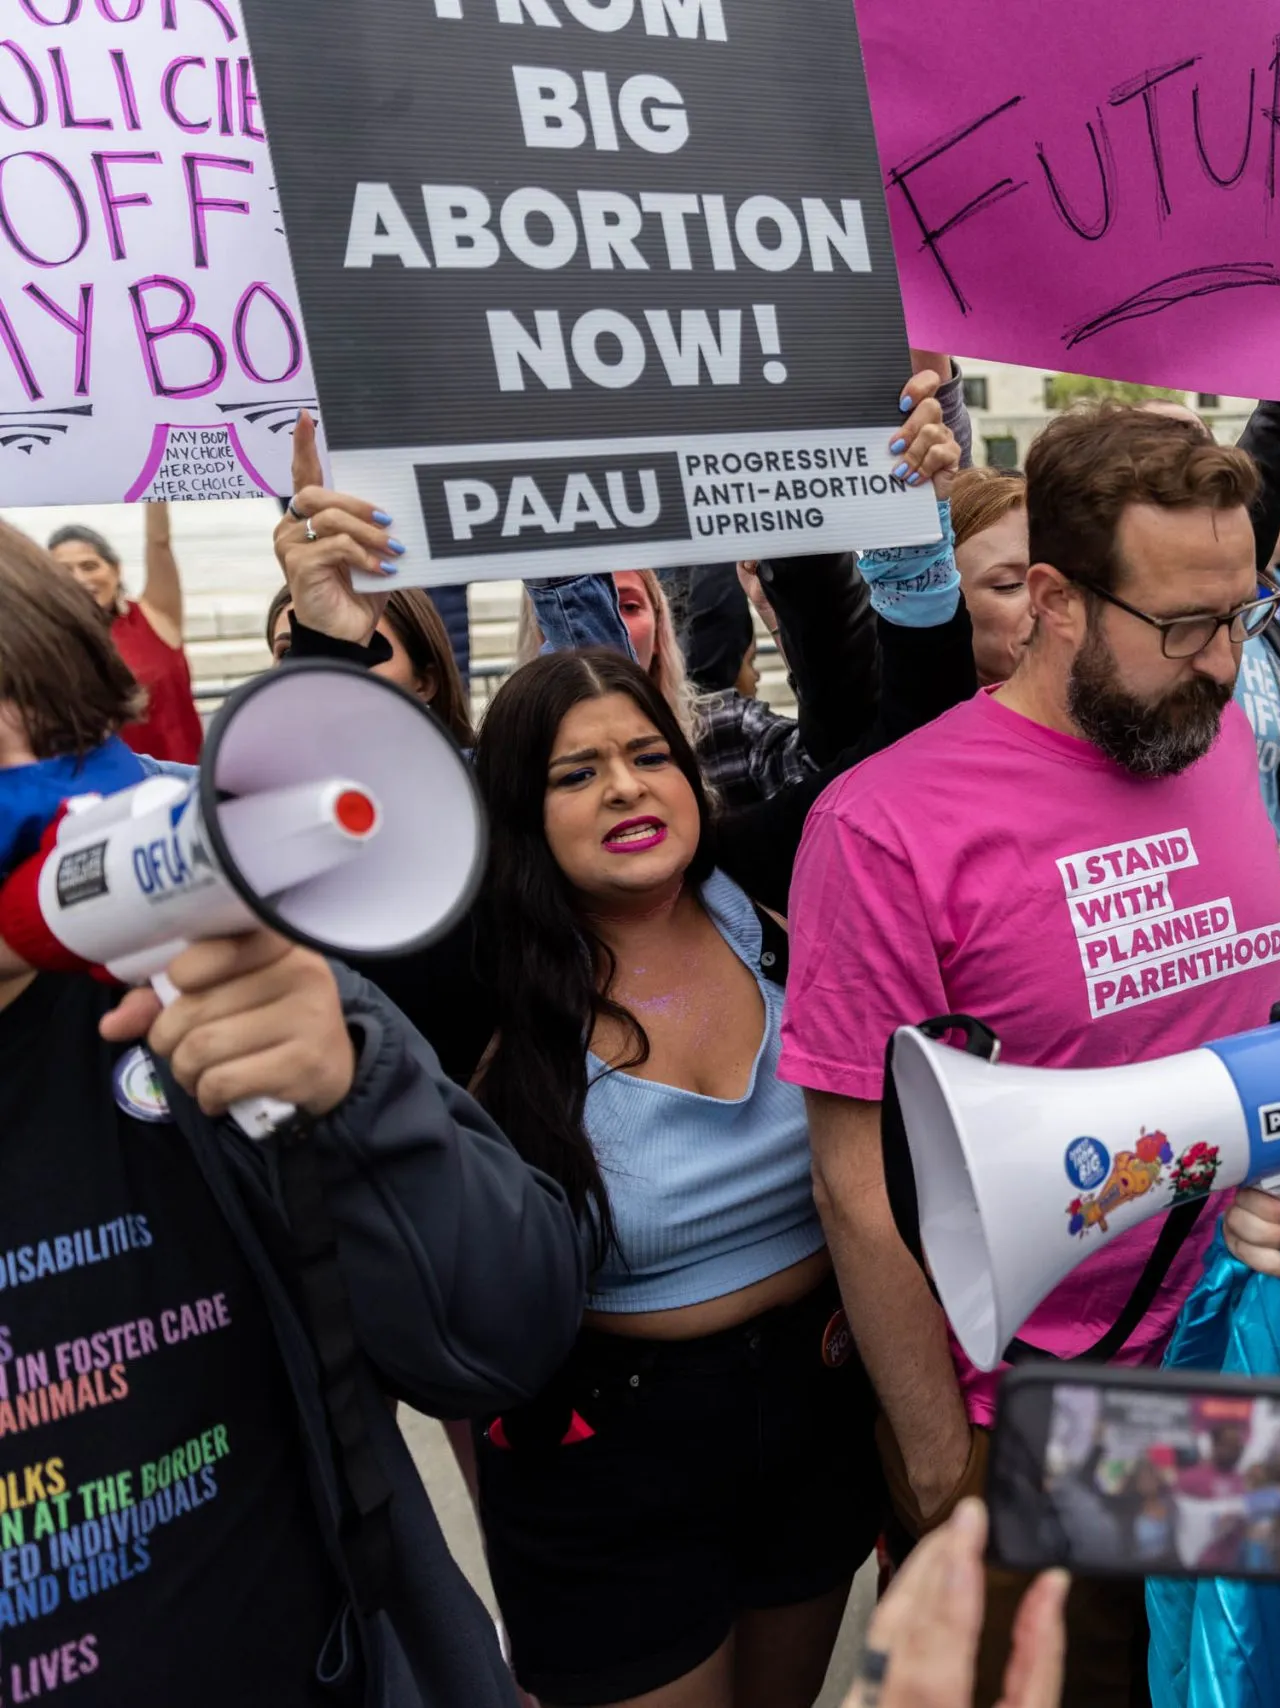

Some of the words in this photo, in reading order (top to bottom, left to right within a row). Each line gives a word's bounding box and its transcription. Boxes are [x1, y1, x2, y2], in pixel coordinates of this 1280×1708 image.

[512, 65, 690, 154] BIG
[0, 150, 254, 269] OFF
[343, 181, 873, 273] ABORTION
[485, 303, 789, 392] NOW!
[159, 462, 192, 479] HER
[194, 460, 234, 475] BODY
[200, 430, 228, 445] BODY
[686, 446, 870, 476] PROGRESSIVE
[153, 479, 190, 495] HER
[191, 474, 245, 491] CHOICE
[443, 469, 662, 541] PAAU
[692, 473, 907, 507] ANTI-ABORTION
[696, 507, 825, 537] UPRISING
[1065, 863, 1078, 890] I
[1085, 837, 1189, 884] STAND
[1076, 881, 1166, 928] WITH
[1085, 906, 1229, 969] PLANNED
[16, 1351, 49, 1393] IN
[55, 1317, 158, 1381] FOSTER
[160, 1292, 232, 1345] CARE
[0, 1363, 129, 1439] ANIMALS
[34, 1491, 71, 1541] AT
[78, 1470, 135, 1521] THE
[140, 1423, 230, 1498] BORDER
[49, 1464, 219, 1571] INDIVIDUALS
[0, 1574, 60, 1631] AND
[68, 1534, 151, 1602] GIRLS
[11, 1633, 99, 1704] LIVES
